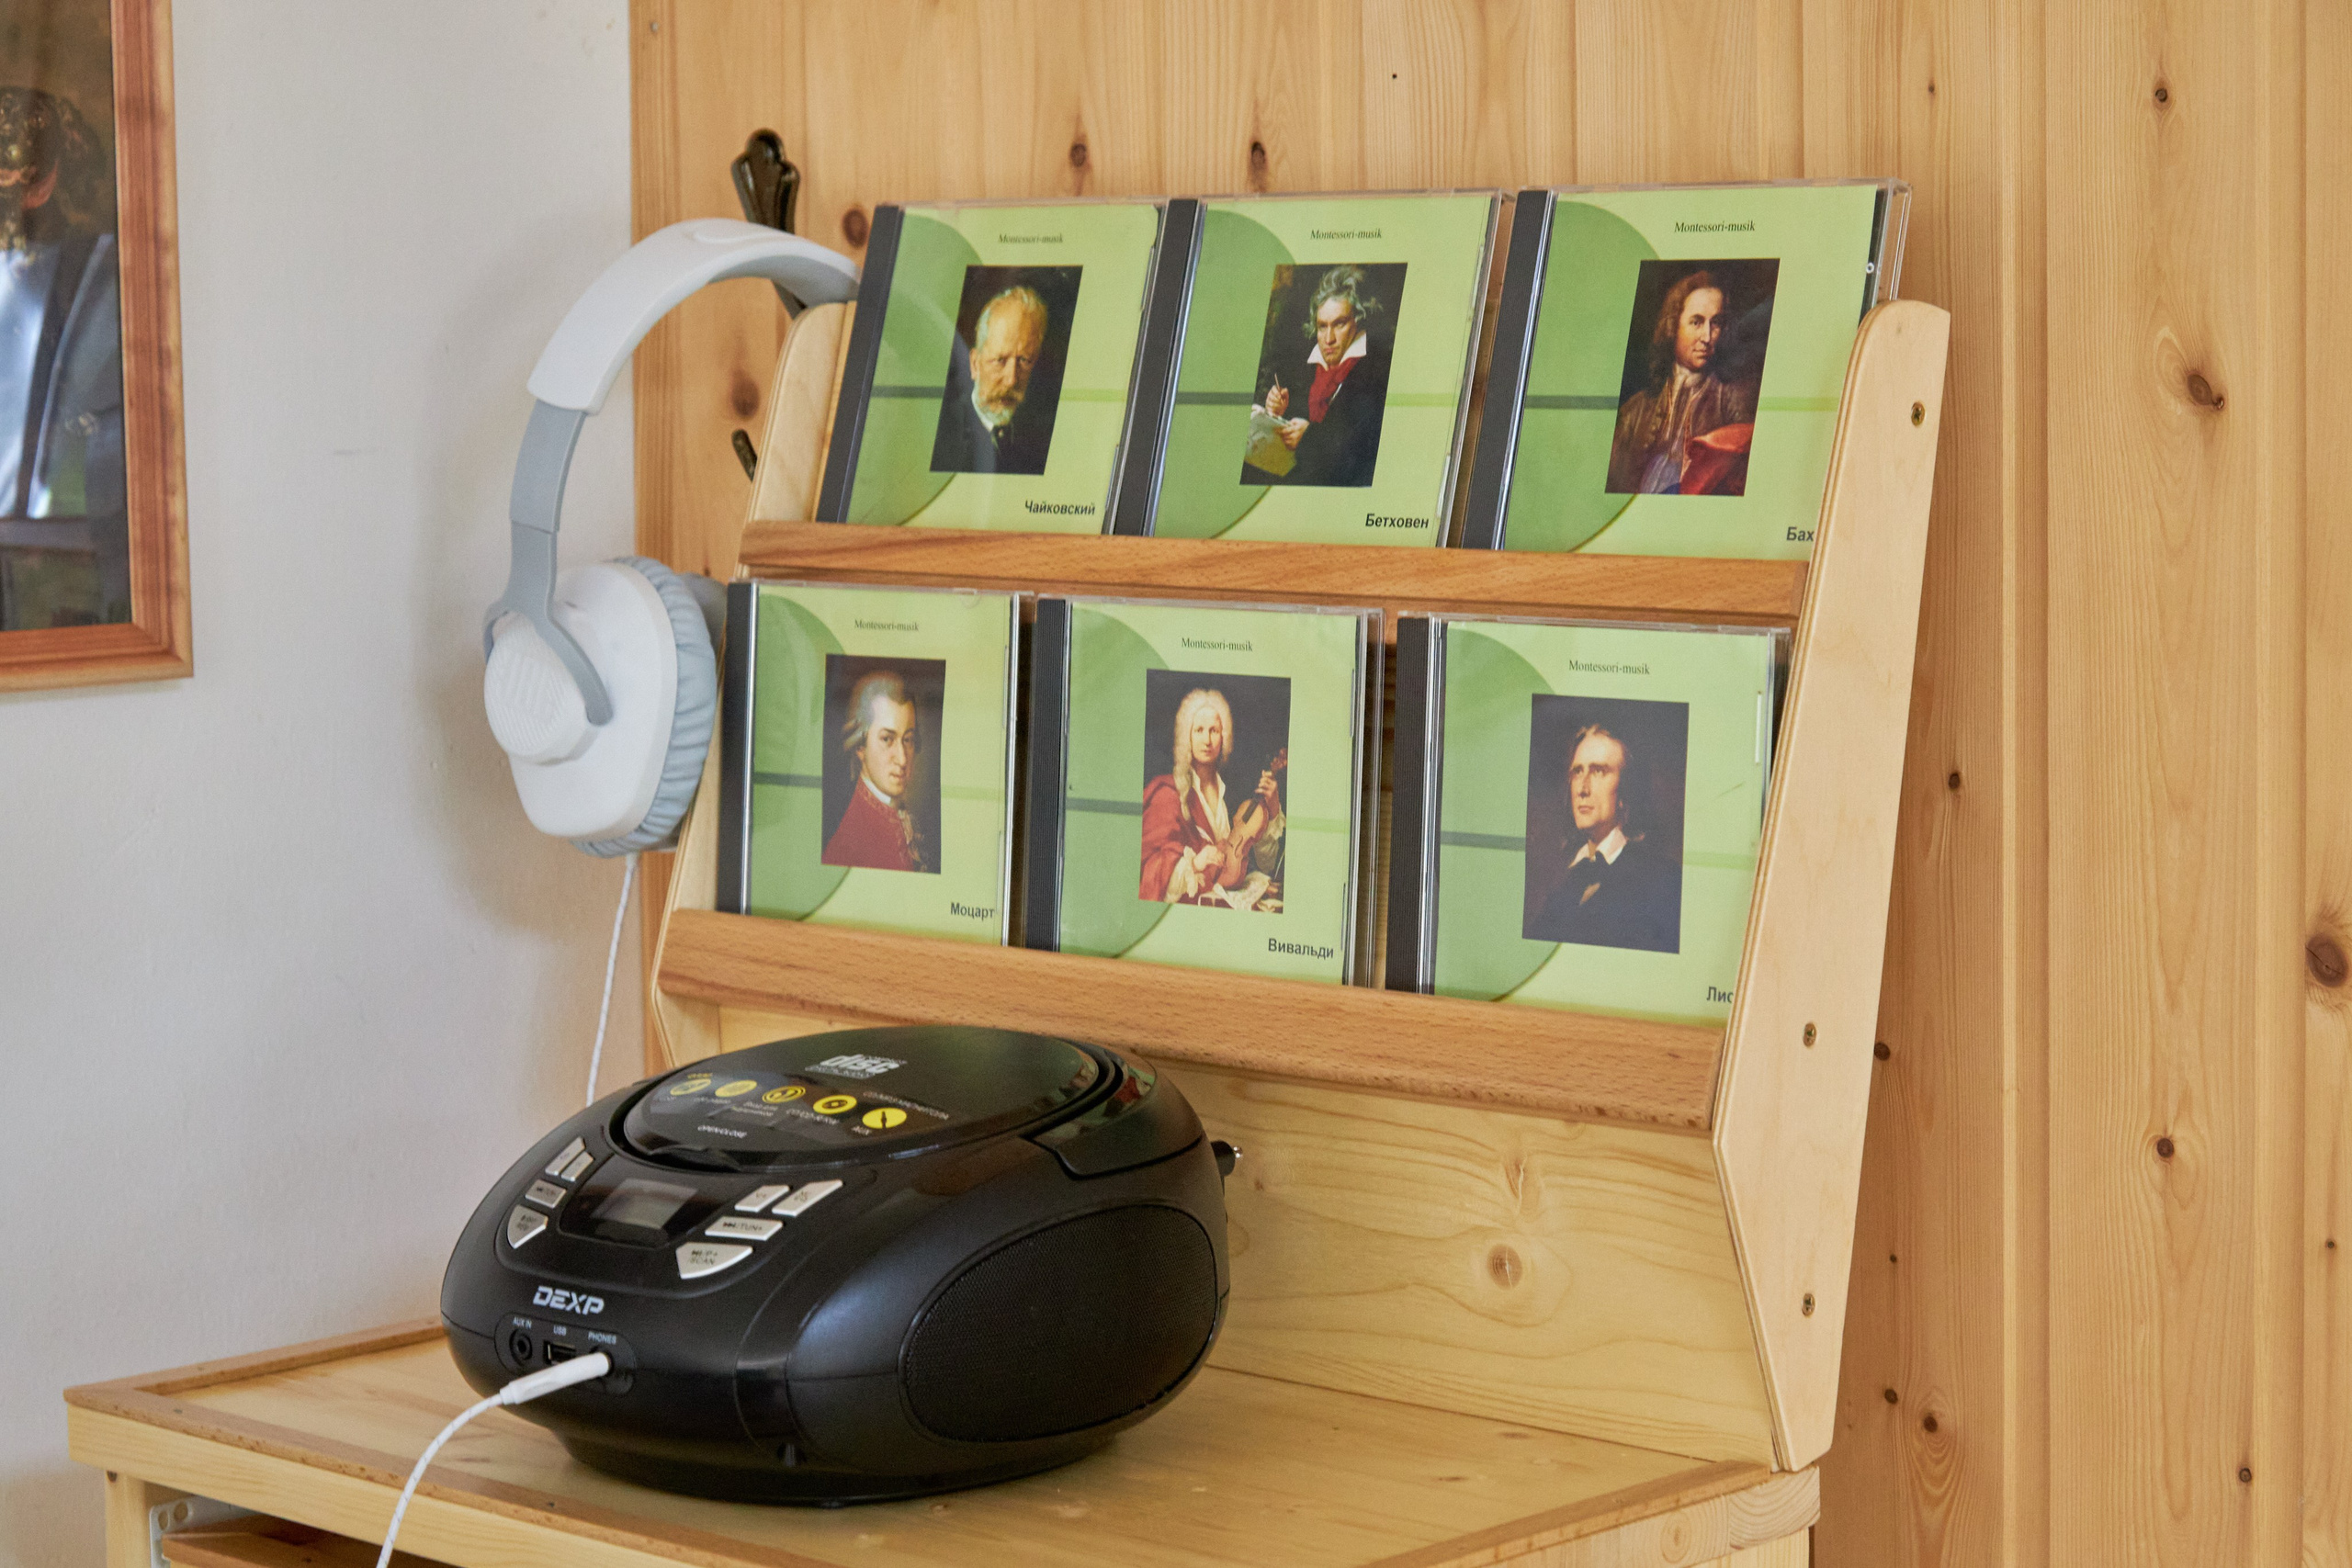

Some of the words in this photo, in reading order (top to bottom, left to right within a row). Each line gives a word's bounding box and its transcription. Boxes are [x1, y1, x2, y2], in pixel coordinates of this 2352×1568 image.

[1674, 220, 1756, 233] Montessori-musik
[998, 232, 1064, 244] Montessori-musik
[1311, 229, 1383, 241] Montessori-musik
[1023, 499, 1097, 516] Чайковский
[1364, 513, 1430, 529] Бетховен
[1786, 526, 1815, 542] Бах
[854, 619, 920, 632] Montessori-musik
[1182, 637, 1253, 652] Montessori-musik
[1568, 659, 1650, 675] Montessori-musik
[950, 902, 996, 921] Моцарт
[1268, 938, 1334, 960] Вивальди
[532, 1284, 605, 1315] DEXP
[512, 1316, 525, 1328] AUX
[525, 1319, 532, 1329] IN
[553, 1325, 567, 1337] USB
[587, 1331, 616, 1345] PHONES
